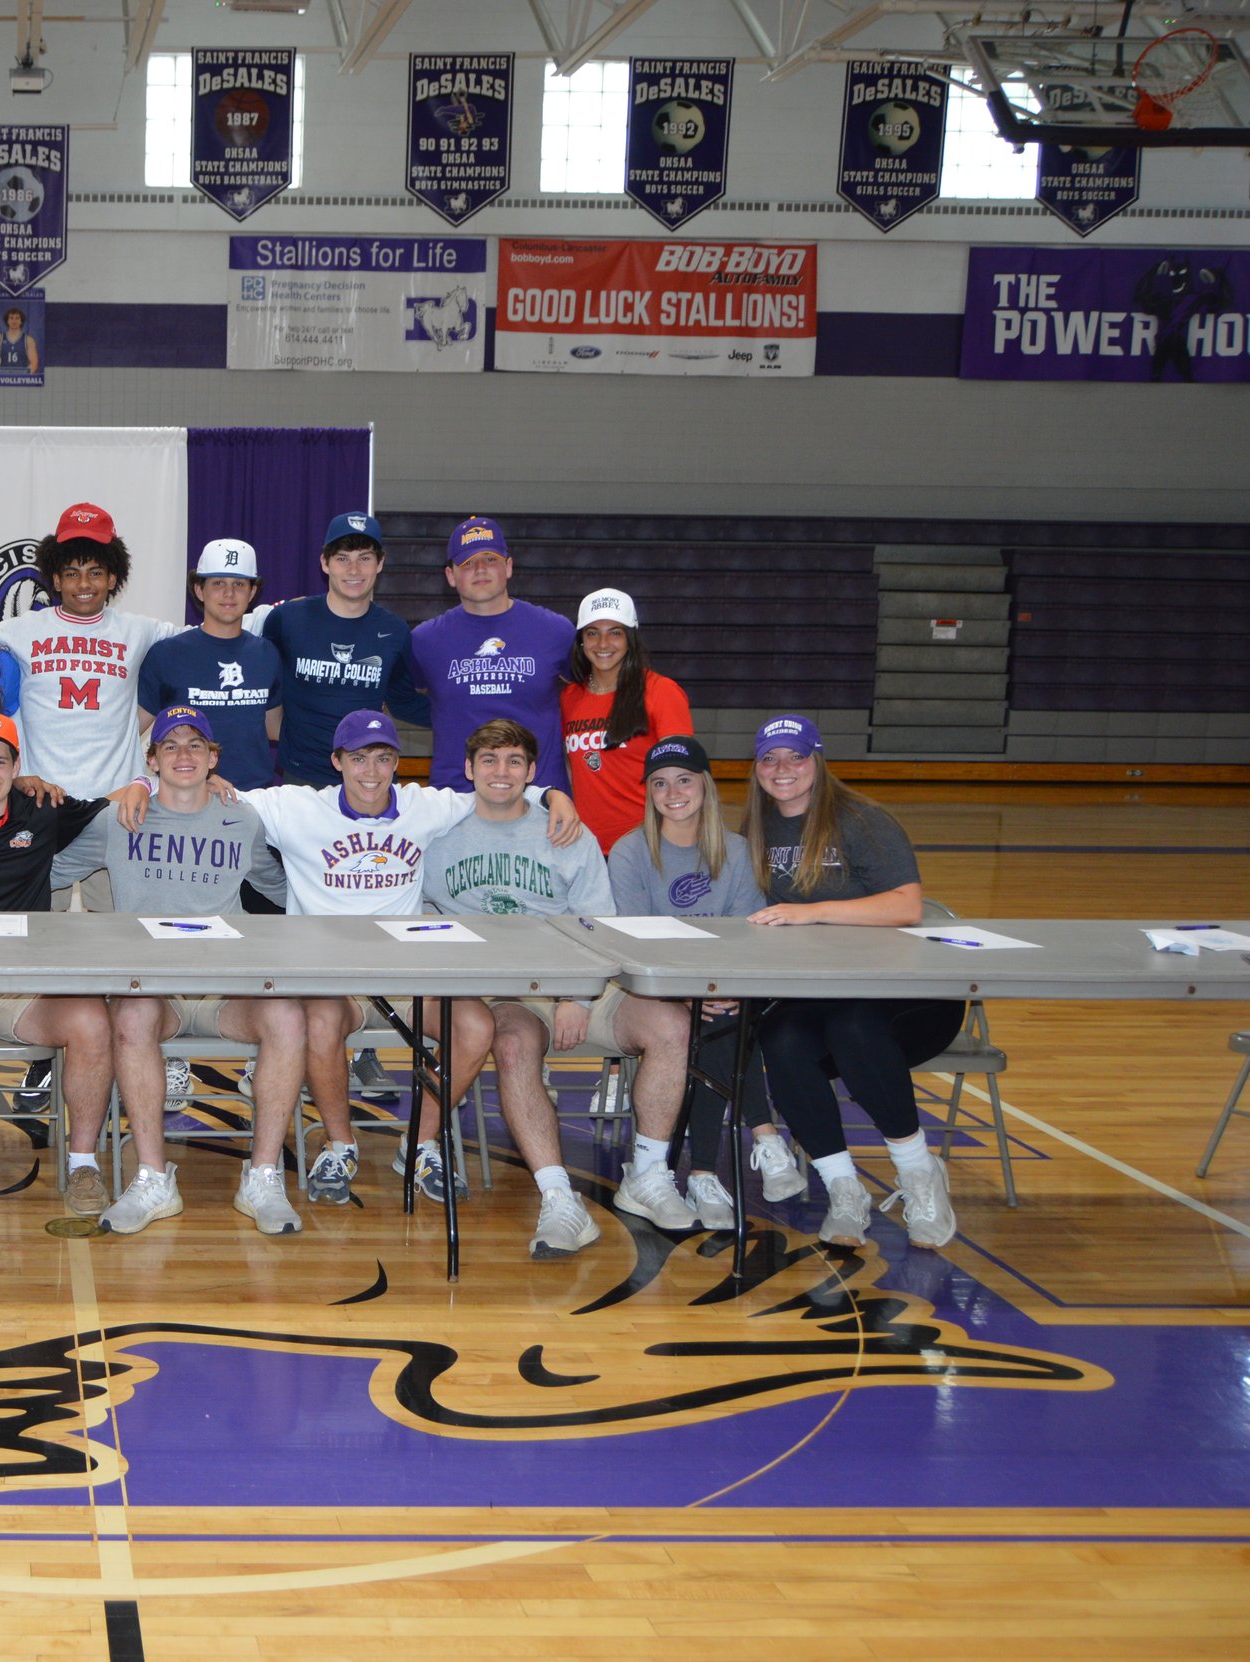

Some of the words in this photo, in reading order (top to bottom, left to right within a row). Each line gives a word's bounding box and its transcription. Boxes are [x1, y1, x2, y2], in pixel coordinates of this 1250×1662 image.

[415, 58, 452, 69] SAINT
[456, 58, 507, 69] FRANCIS
[853, 62, 890, 74] SAINT
[198, 67, 287, 96] DeSALES
[416, 73, 505, 101] DeSALES
[635, 77, 724, 105] DeSALES
[852, 78, 942, 108] DeSALES
[227, 113, 259, 126] 1987
[12, 128, 62, 140] FRANCIS
[663, 122, 695, 135] 1992
[878, 124, 911, 136] 1995
[419, 138, 435, 150] 90
[440, 138, 455, 150] 91
[461, 138, 477, 150] 92
[482, 138, 498, 150] 93
[442, 153, 475, 163] OHSAA
[412, 166, 442, 177] STATE
[446, 166, 504, 177] CHAMPIONS
[199, 175, 221, 184] BOYS
[224, 175, 283, 184] BASKETBALL
[415, 181, 438, 189] BOYS
[441, 181, 500, 190] GYMNASTICS
[645, 184, 668, 193] BOYS
[671, 185, 703, 194] SOCCER
[857, 186, 884, 195] GIRLS
[887, 186, 920, 196] SOCCER
[1057, 191, 1079, 200] BOYS
[1082, 191, 1115, 200] SOCCER
[0, 223, 32, 235] OHSAA
[4, 237, 61, 248] CHAMPIONS
[12, 252, 51, 261] SOCCER
[257, 240, 361, 267] Stallions
[371, 243, 404, 267] for
[413, 243, 457, 268] Life
[511, 253, 573, 265] bobboyd.com
[655, 245, 806, 275] BOB-BOYD
[271, 281, 322, 291] Pregnancy
[324, 281, 366, 290] Decision
[993, 274, 1061, 308] THE
[271, 292, 302, 300] Health
[304, 292, 341, 301] Centers
[507, 288, 576, 324] GOOD
[583, 290, 652, 325] LUCK
[660, 292, 805, 328] STALLIONS!
[993, 310, 1159, 356] POWER
[8, 353, 18, 362] 16
[275, 355, 352, 367] SupportPDHC.org
[728, 350, 752, 362] Jeep
[31, 637, 127, 661] MARIST
[31, 659, 67, 675] RED
[71, 660, 128, 679] FOXES
[296, 658, 340, 678] MARIETTA
[344, 664, 382, 682] COLLEGE
[448, 657, 535, 678] ASHLAND
[58, 677, 101, 710] M
[188, 688, 229, 700] PENN
[470, 684, 512, 694] BASEBALL
[167, 708, 197, 717] KENYON
[128, 832, 241, 871] KENYON
[321, 832, 422, 869] ASHLAND
[145, 868, 219, 885] COLLEGE
[325, 869, 415, 890] UNIVERSITY
[446, 852, 511, 899] CLEVELAND
[515, 855, 554, 899] STATE
